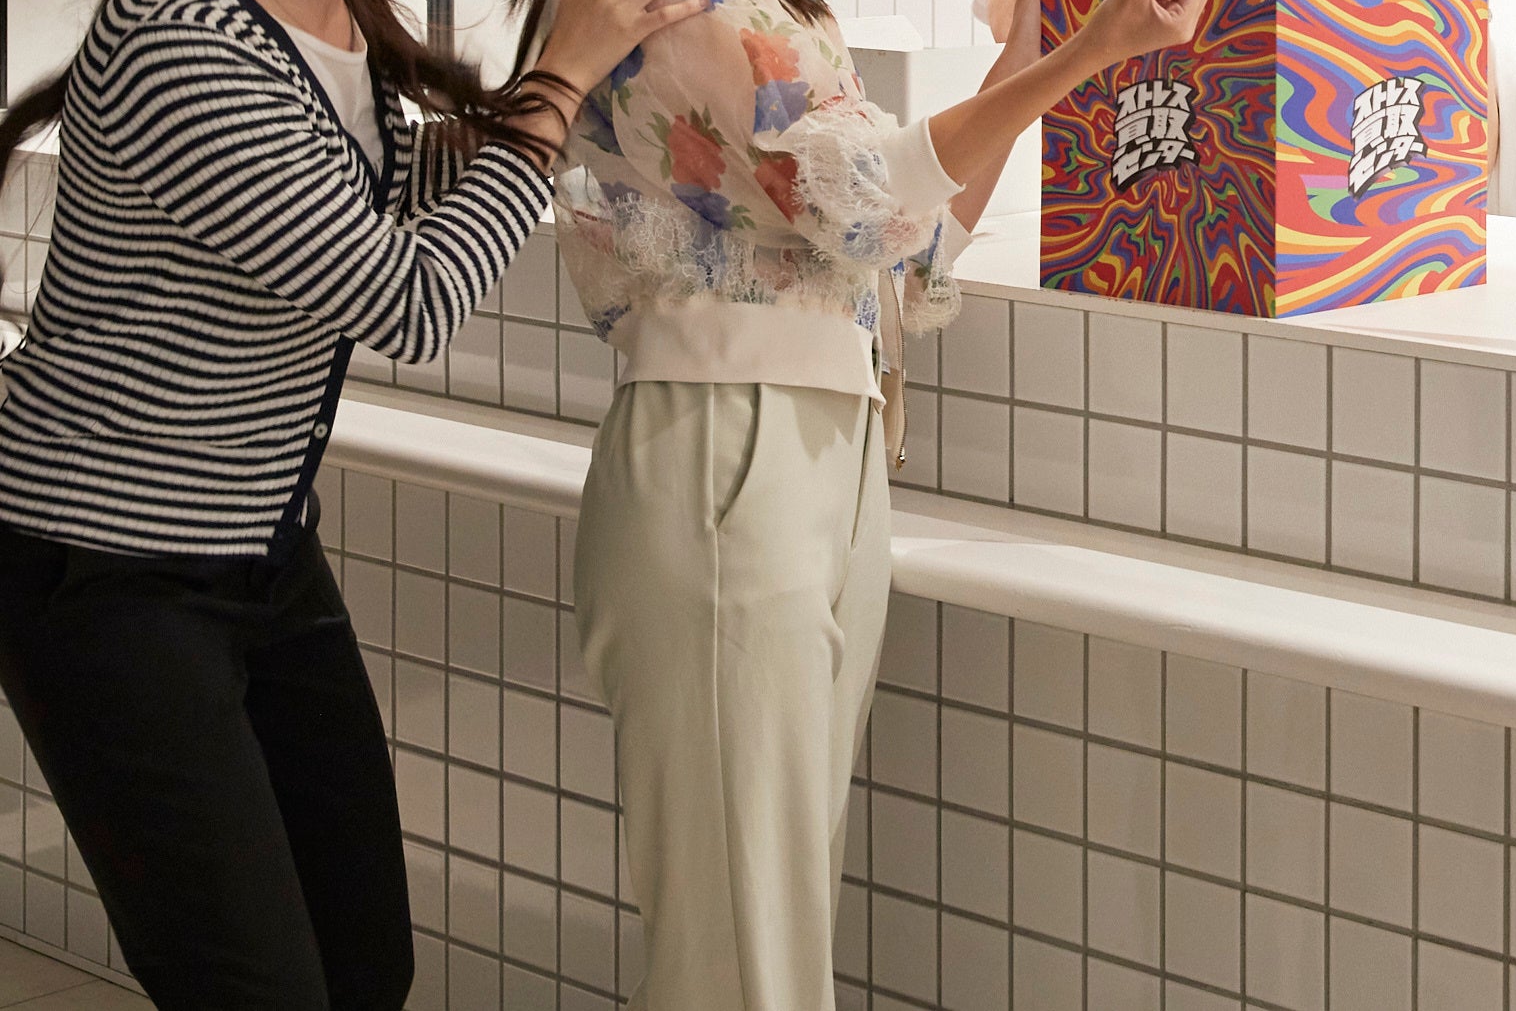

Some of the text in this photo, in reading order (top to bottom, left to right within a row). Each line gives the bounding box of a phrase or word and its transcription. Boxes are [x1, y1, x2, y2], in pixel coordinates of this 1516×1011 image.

[1116, 80, 1192, 122] ストレス
[1352, 78, 1422, 129] ストレス
[1115, 107, 1191, 148] 買取
[1351, 104, 1420, 155] 買取
[1112, 140, 1195, 186] センター
[1349, 136, 1424, 193] センター
